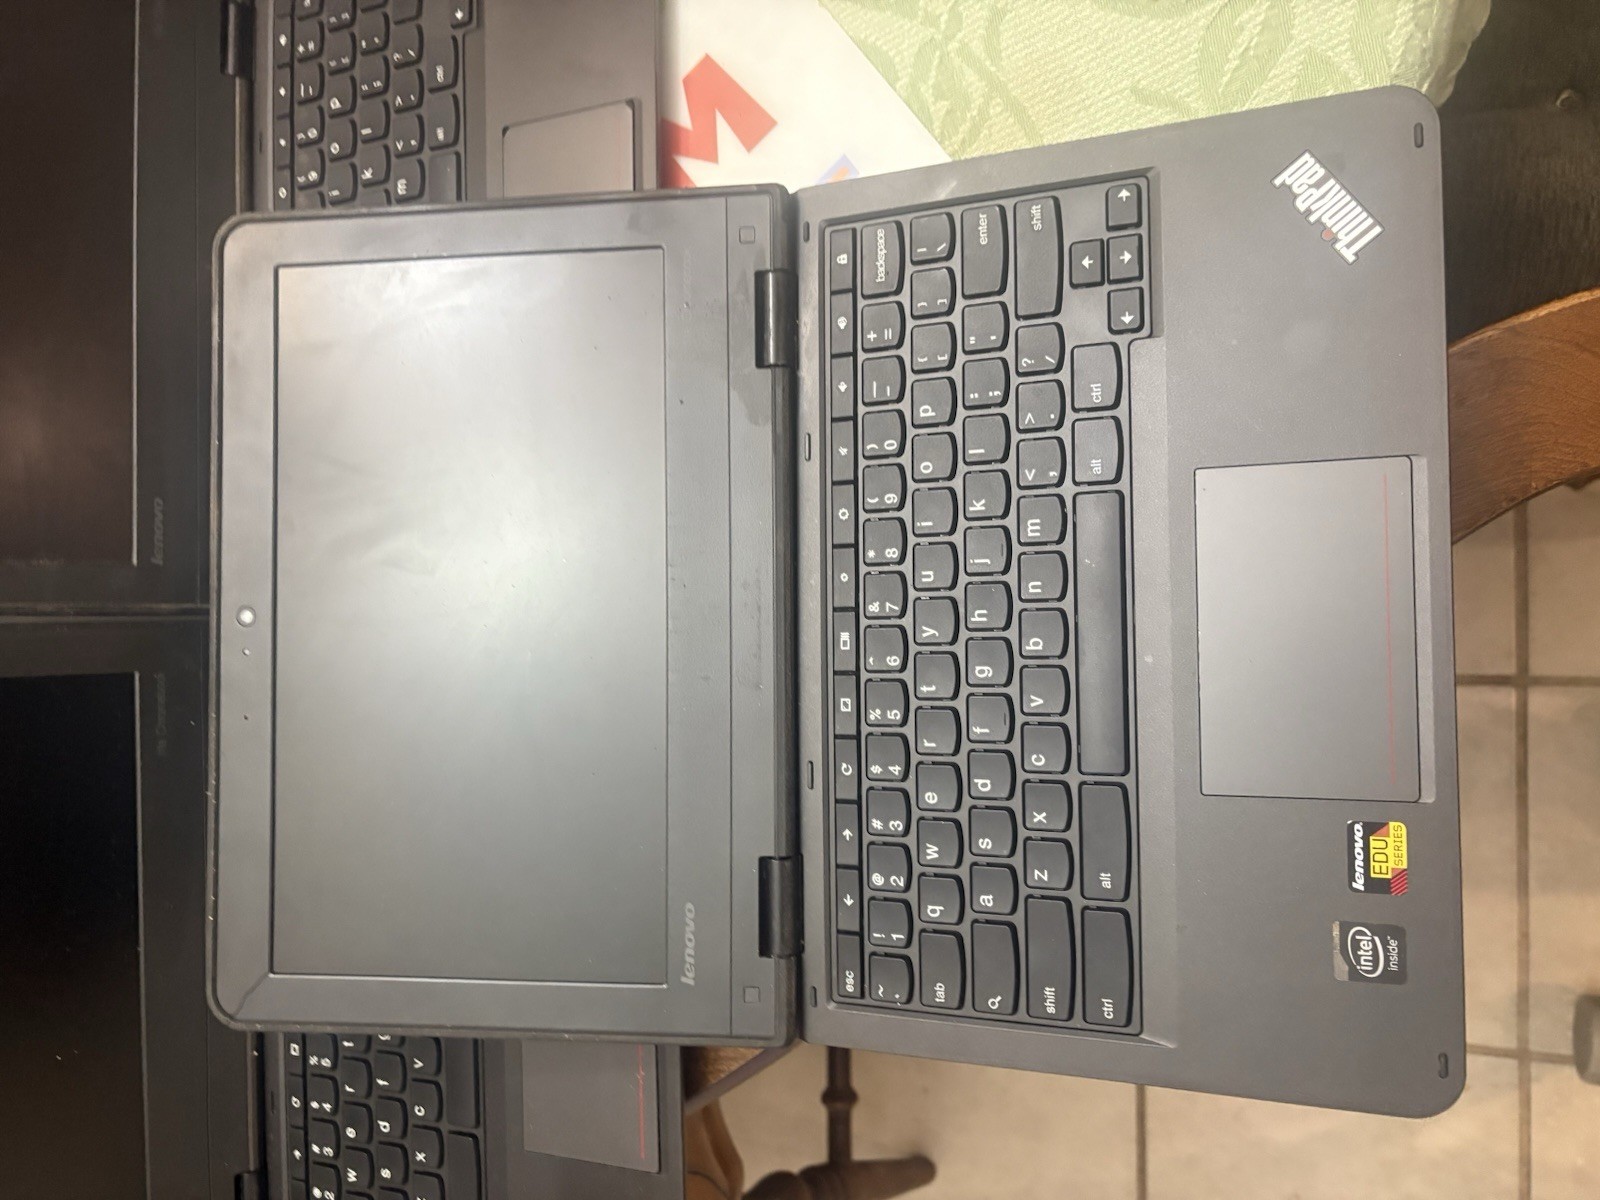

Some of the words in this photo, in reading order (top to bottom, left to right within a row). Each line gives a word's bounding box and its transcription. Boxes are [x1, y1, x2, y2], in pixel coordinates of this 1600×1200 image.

[330, 142, 340, 155] o
[361, 167, 373, 180] k
[1273, 151, 1382, 264] ThinkPad
[1030, 204, 1042, 231] shift
[977, 212, 988, 245] enter
[875, 228, 888, 283] backspace
[1090, 383, 1102, 403] ctrl
[919, 404, 937, 418] p
[883, 439, 898, 451] 0
[919, 461, 934, 474] o
[1089, 458, 1102, 475] alt
[884, 493, 898, 504] 9
[968, 498, 986, 512] k
[151, 496, 164, 566] lenovo
[1026, 518, 1041, 537] m
[884, 547, 899, 559] 8
[921, 570, 935, 583] u
[1027, 581, 1042, 593] n
[868, 601, 880, 613] &
[885, 601, 900, 613] 7
[970, 609, 988, 622] h
[921, 625, 939, 638] y
[1025, 637, 1044, 651] b
[885, 655, 901, 667] 6
[974, 665, 993, 679] g
[919, 684, 937, 693] t
[1029, 694, 1044, 708] v
[869, 708, 882, 721] %
[886, 709, 901, 721] 5
[972, 726, 990, 735] f
[923, 738, 937, 748] r
[1031, 753, 1046, 767] c
[869, 764, 883, 775] $
[887, 764, 902, 776] 4
[973, 778, 992, 792] d
[924, 791, 938, 805] e
[871, 818, 884, 831] #
[1032, 811, 1047, 824] x
[888, 820, 904, 831] 3
[978, 837, 993, 850] s
[1393, 824, 1403, 867] SERIES
[925, 843, 939, 860] w
[1351, 821, 1366, 892] lenovo
[1372, 838, 1390, 876] EDU
[871, 872, 885, 886] @
[889, 875, 904, 887] 2
[1034, 868, 1049, 882] z
[1098, 872, 1112, 889] alt
[979, 894, 994, 908] a
[926, 904, 945, 918] q
[681, 901, 695, 987] lenovo
[1355, 935, 1374, 971] intel
[845, 970, 855, 993] esc
[933, 982, 946, 1003] tab
[1043, 986, 1056, 1014] shift
[1101, 998, 1114, 1020] ctrl
[413, 1058, 424, 1069] v
[414, 1105, 425, 1117] c
[377, 1120, 391, 1133] d
[415, 1151, 426, 1163] x
[346, 1167, 358, 1182] w
[380, 1168, 392, 1179] s
